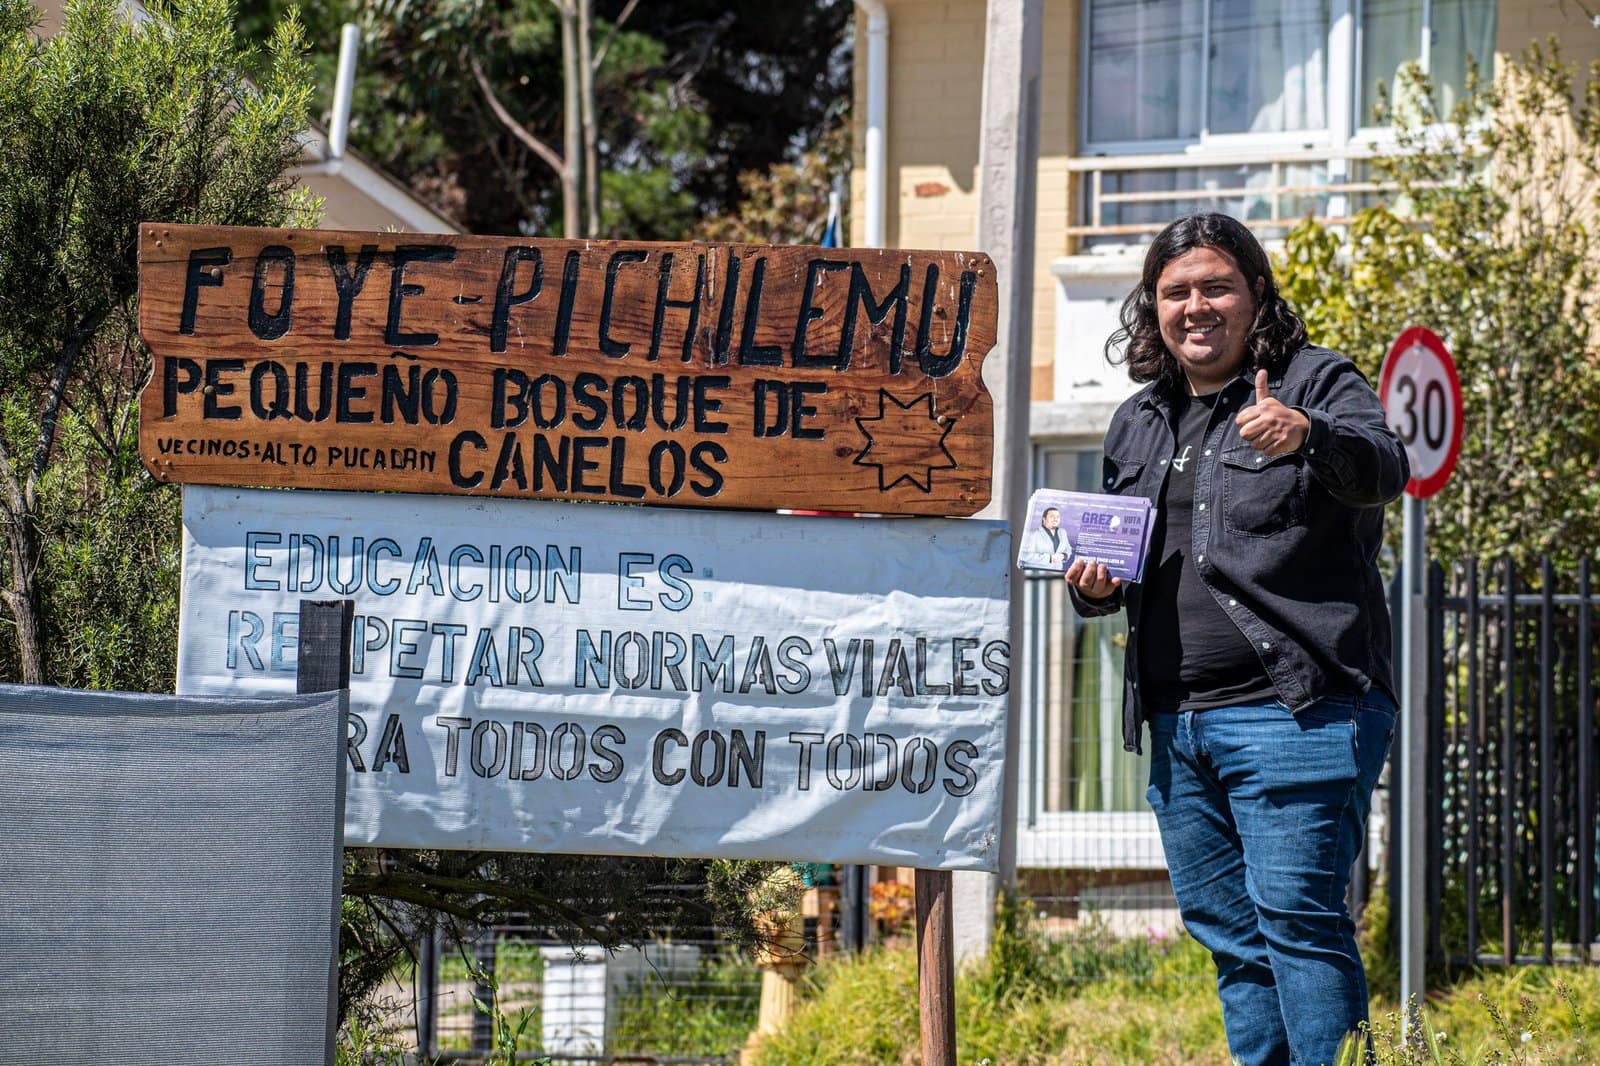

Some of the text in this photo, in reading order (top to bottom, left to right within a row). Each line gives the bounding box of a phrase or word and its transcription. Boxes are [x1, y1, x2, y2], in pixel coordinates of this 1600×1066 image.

[162, 352, 828, 440] PEQUEÑO BOSQUE DE
[1395, 374, 1447, 452] 30
[448, 430, 728, 498] CANELOS
[244, 531, 583, 604] EDUCACION
[226, 610, 1011, 698] REPETAR NORMAS VIALES
[436, 716, 627, 784] TODOS
[652, 727, 767, 789] CON
[788, 731, 980, 798] TODOS
